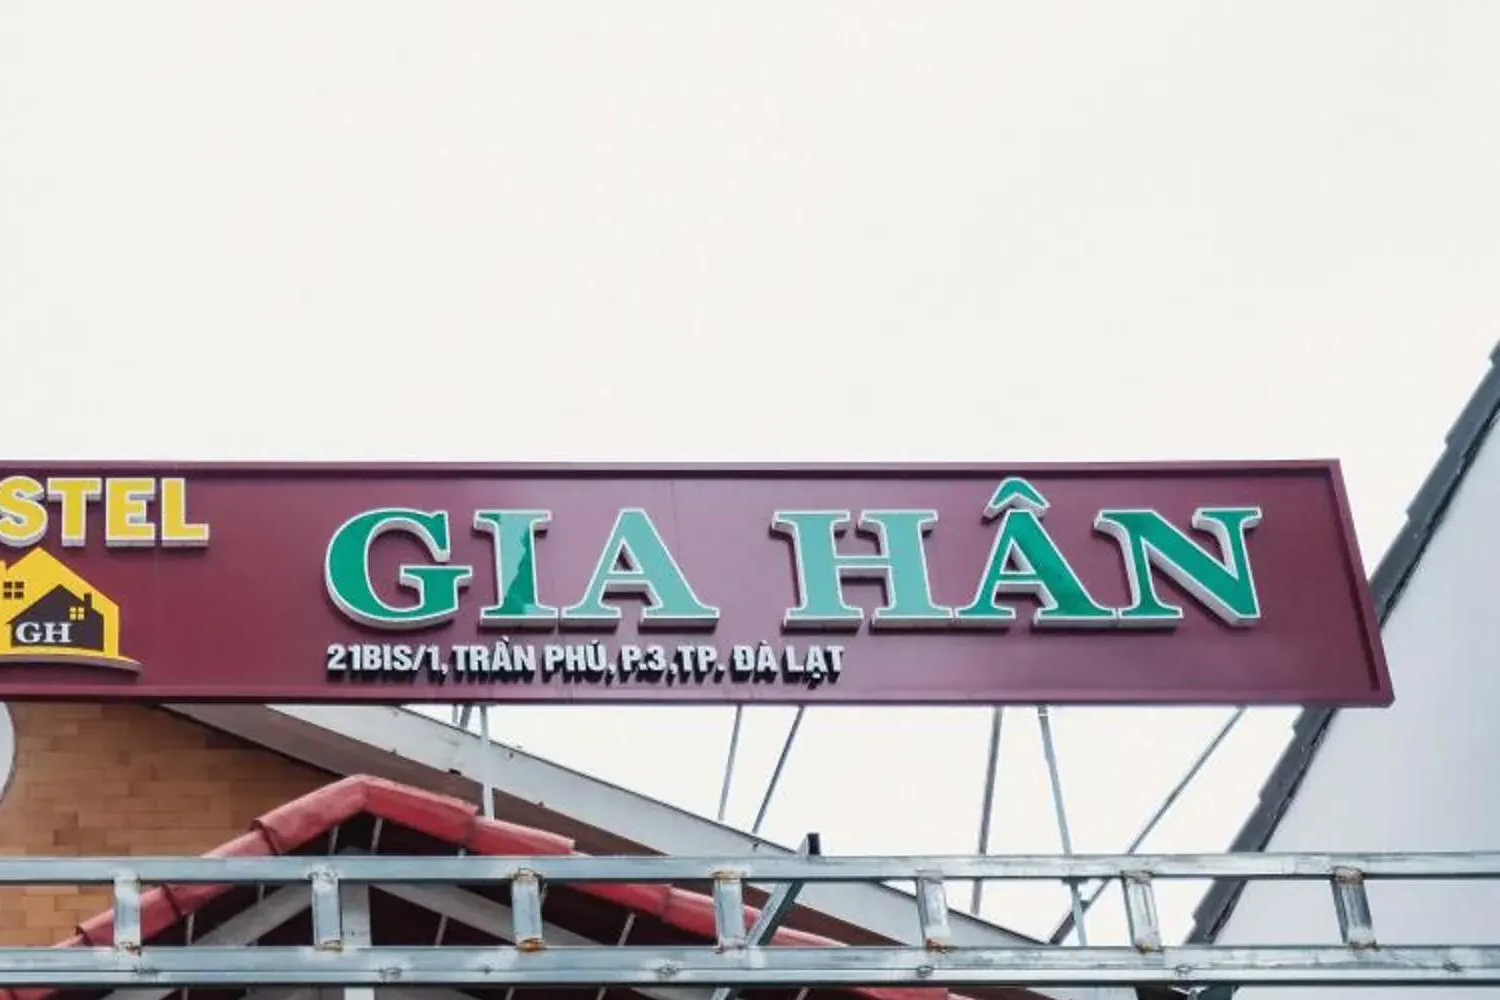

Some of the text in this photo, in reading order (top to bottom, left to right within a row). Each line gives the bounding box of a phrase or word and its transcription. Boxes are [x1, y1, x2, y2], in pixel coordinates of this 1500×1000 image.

[323, 476, 1263, 629] GIA HÂN
[15, 620, 73, 644] GH
[786, 645, 845, 679] LẠT
